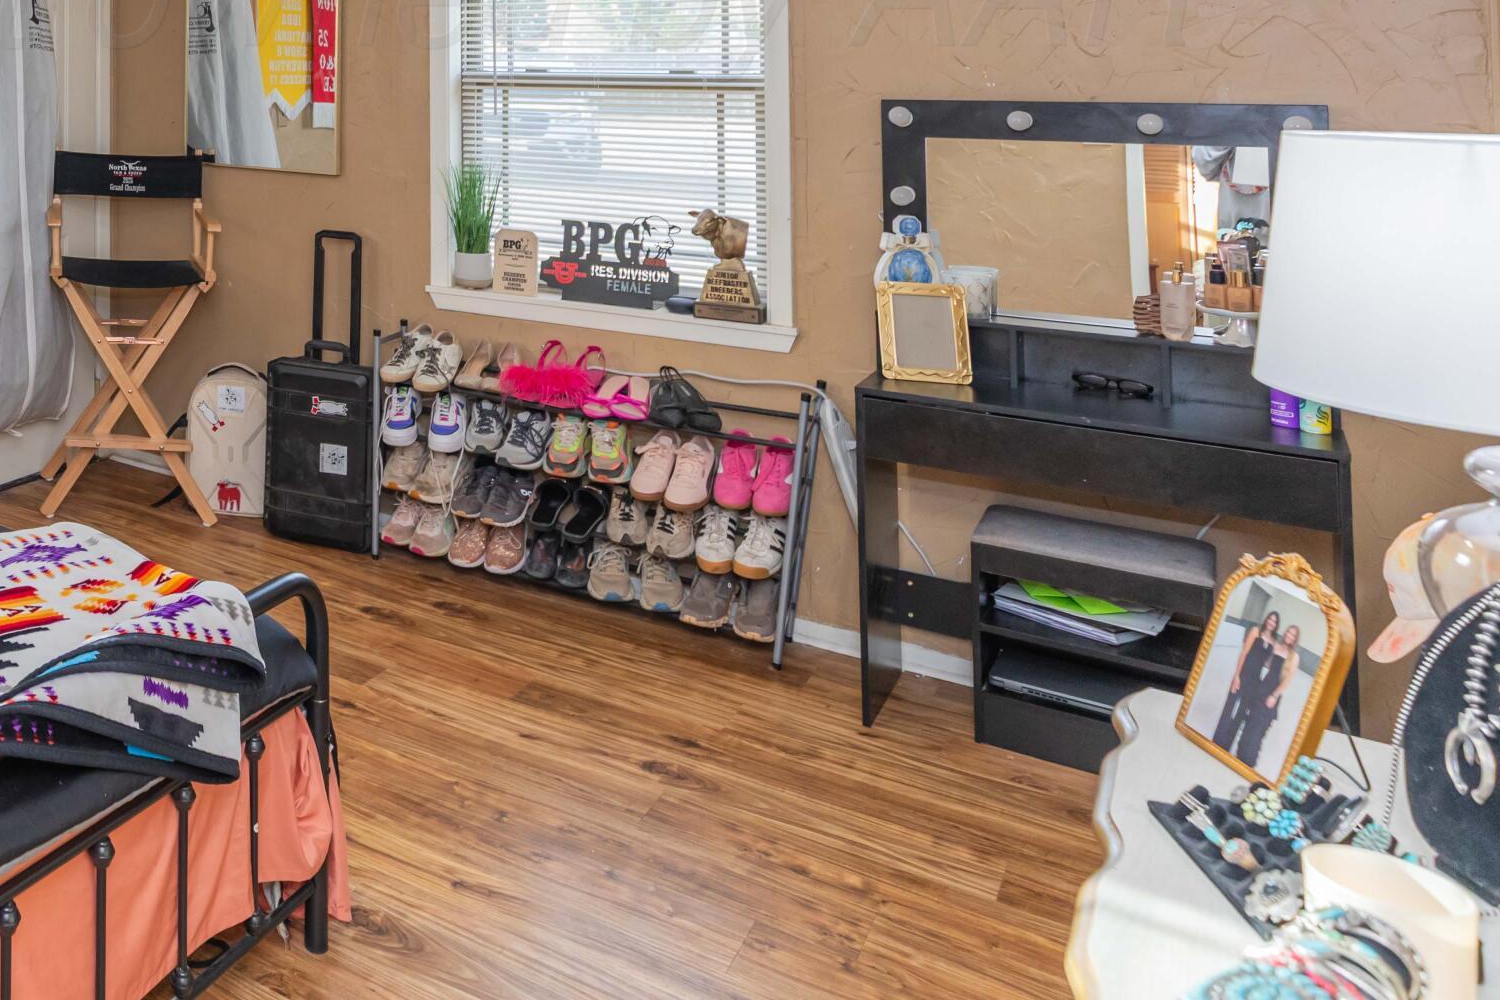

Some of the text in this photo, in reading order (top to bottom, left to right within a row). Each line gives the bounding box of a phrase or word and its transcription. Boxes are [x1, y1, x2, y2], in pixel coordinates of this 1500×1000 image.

[503, 239, 521, 249] BPG
[560, 220, 640, 267] BPG
[590, 265, 669, 283] RES. DIVISION
[714, 272, 738, 280] JUNIOR
[606, 280, 652, 295] FEMALE
[707, 278, 748, 288] BEEFMASTER
[710, 286, 742, 295] BREEDERS
[705, 293, 750, 304] ASSOCIATION
